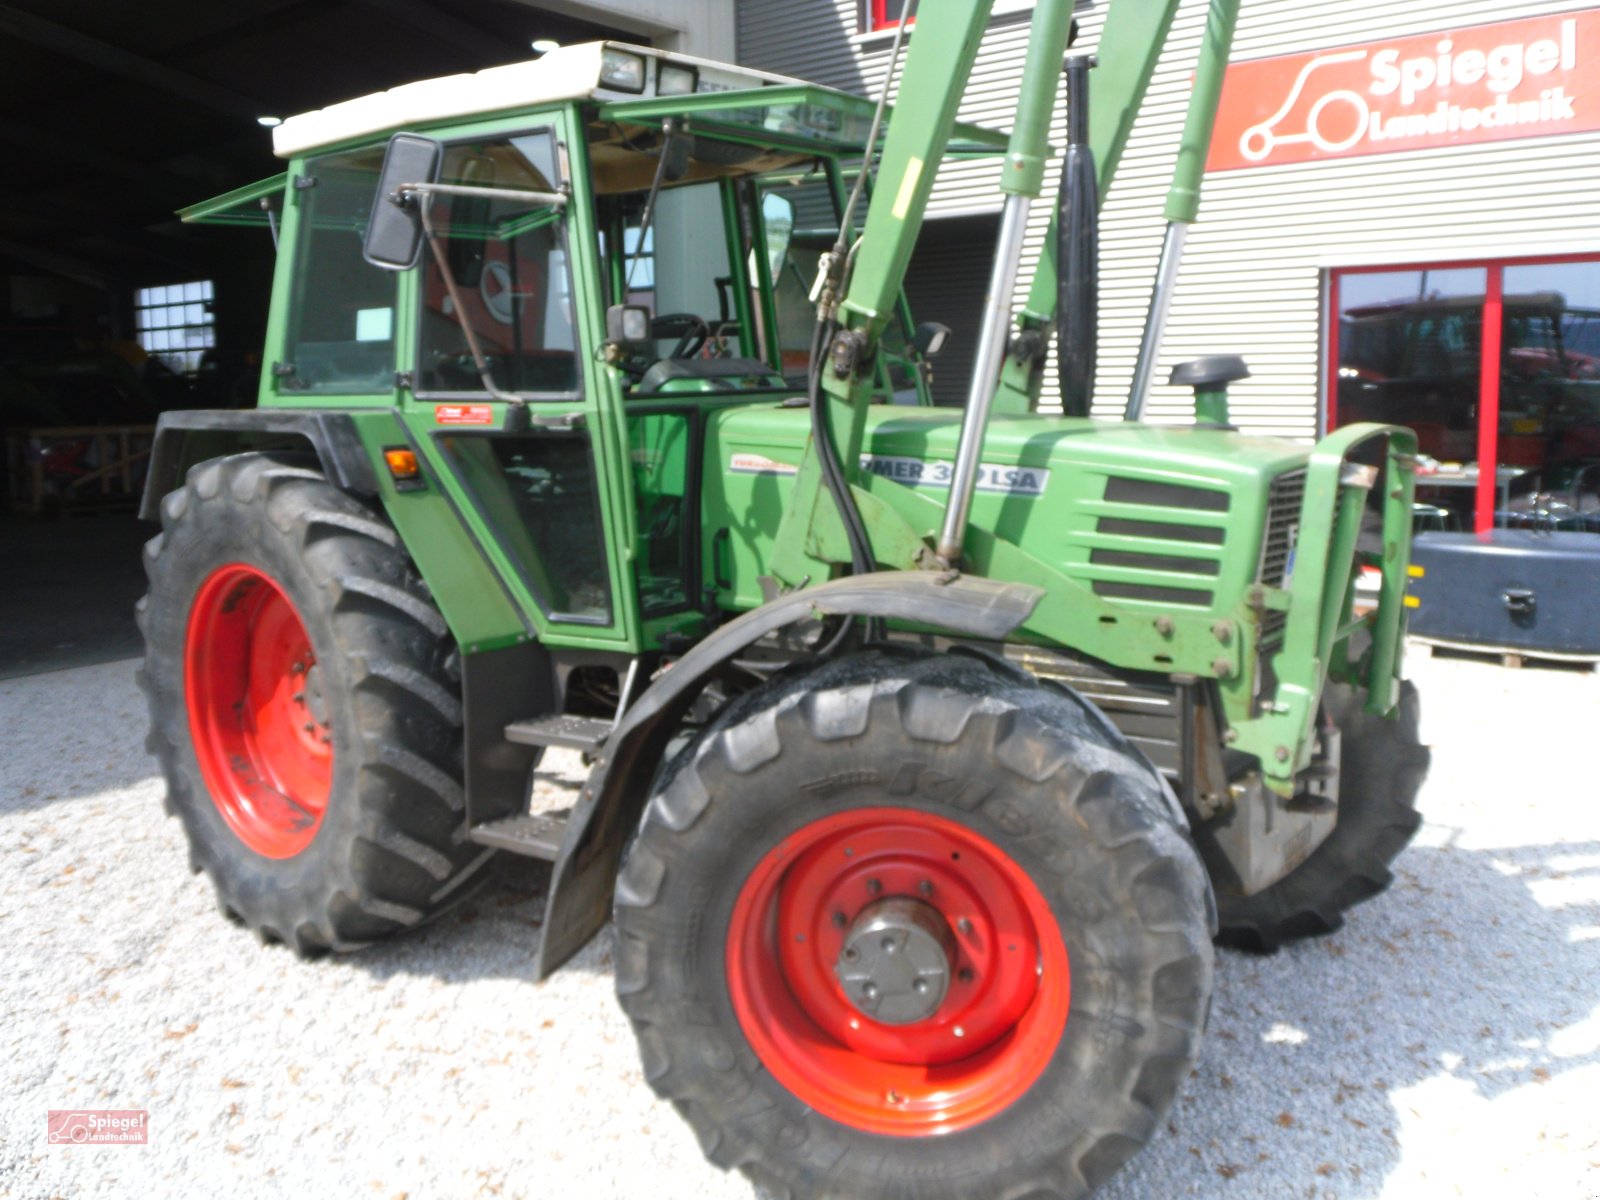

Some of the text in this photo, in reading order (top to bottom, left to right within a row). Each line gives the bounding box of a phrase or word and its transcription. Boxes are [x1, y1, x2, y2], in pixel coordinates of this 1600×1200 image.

[1369, 18, 1577, 104] Spiegel
[1369, 86, 1577, 141] Landtechnik
[991, 468, 1038, 489] LSA
